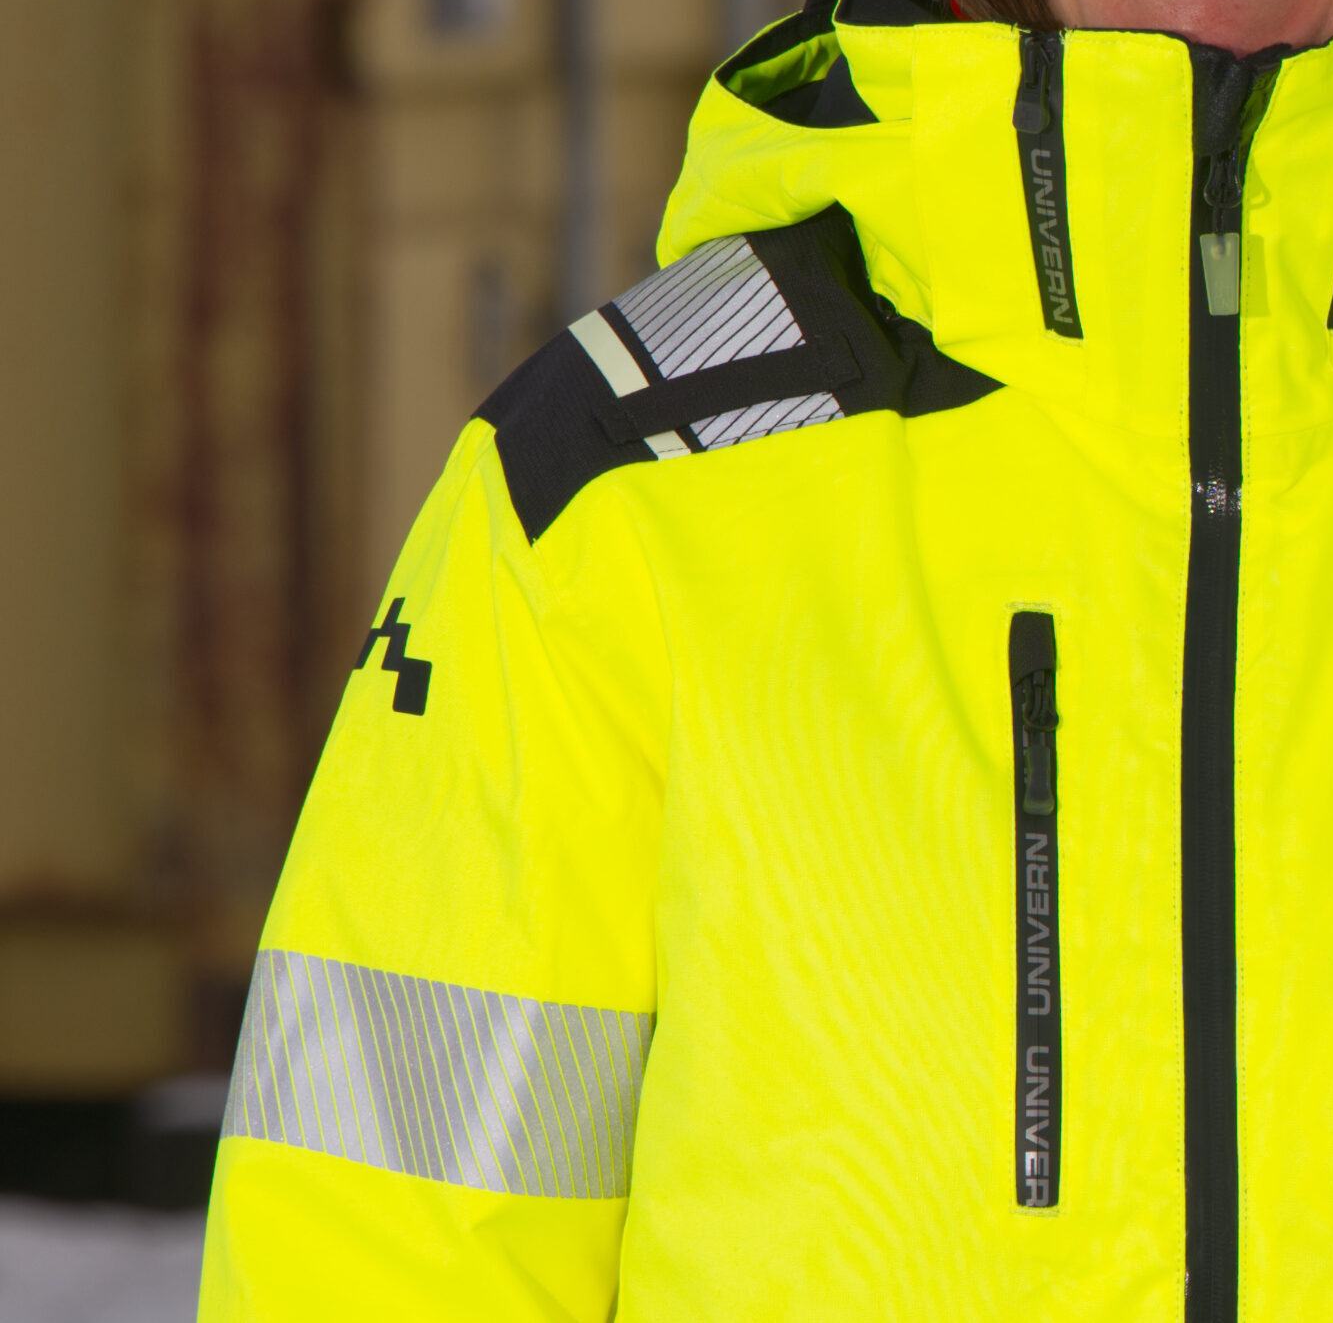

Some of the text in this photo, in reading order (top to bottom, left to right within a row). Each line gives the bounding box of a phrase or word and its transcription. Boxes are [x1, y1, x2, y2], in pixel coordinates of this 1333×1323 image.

[1030, 148, 1074, 325] UNIVERN
[1025, 832, 1051, 1016] UNIVERN
[1024, 1045, 1050, 1208] UNIVER
